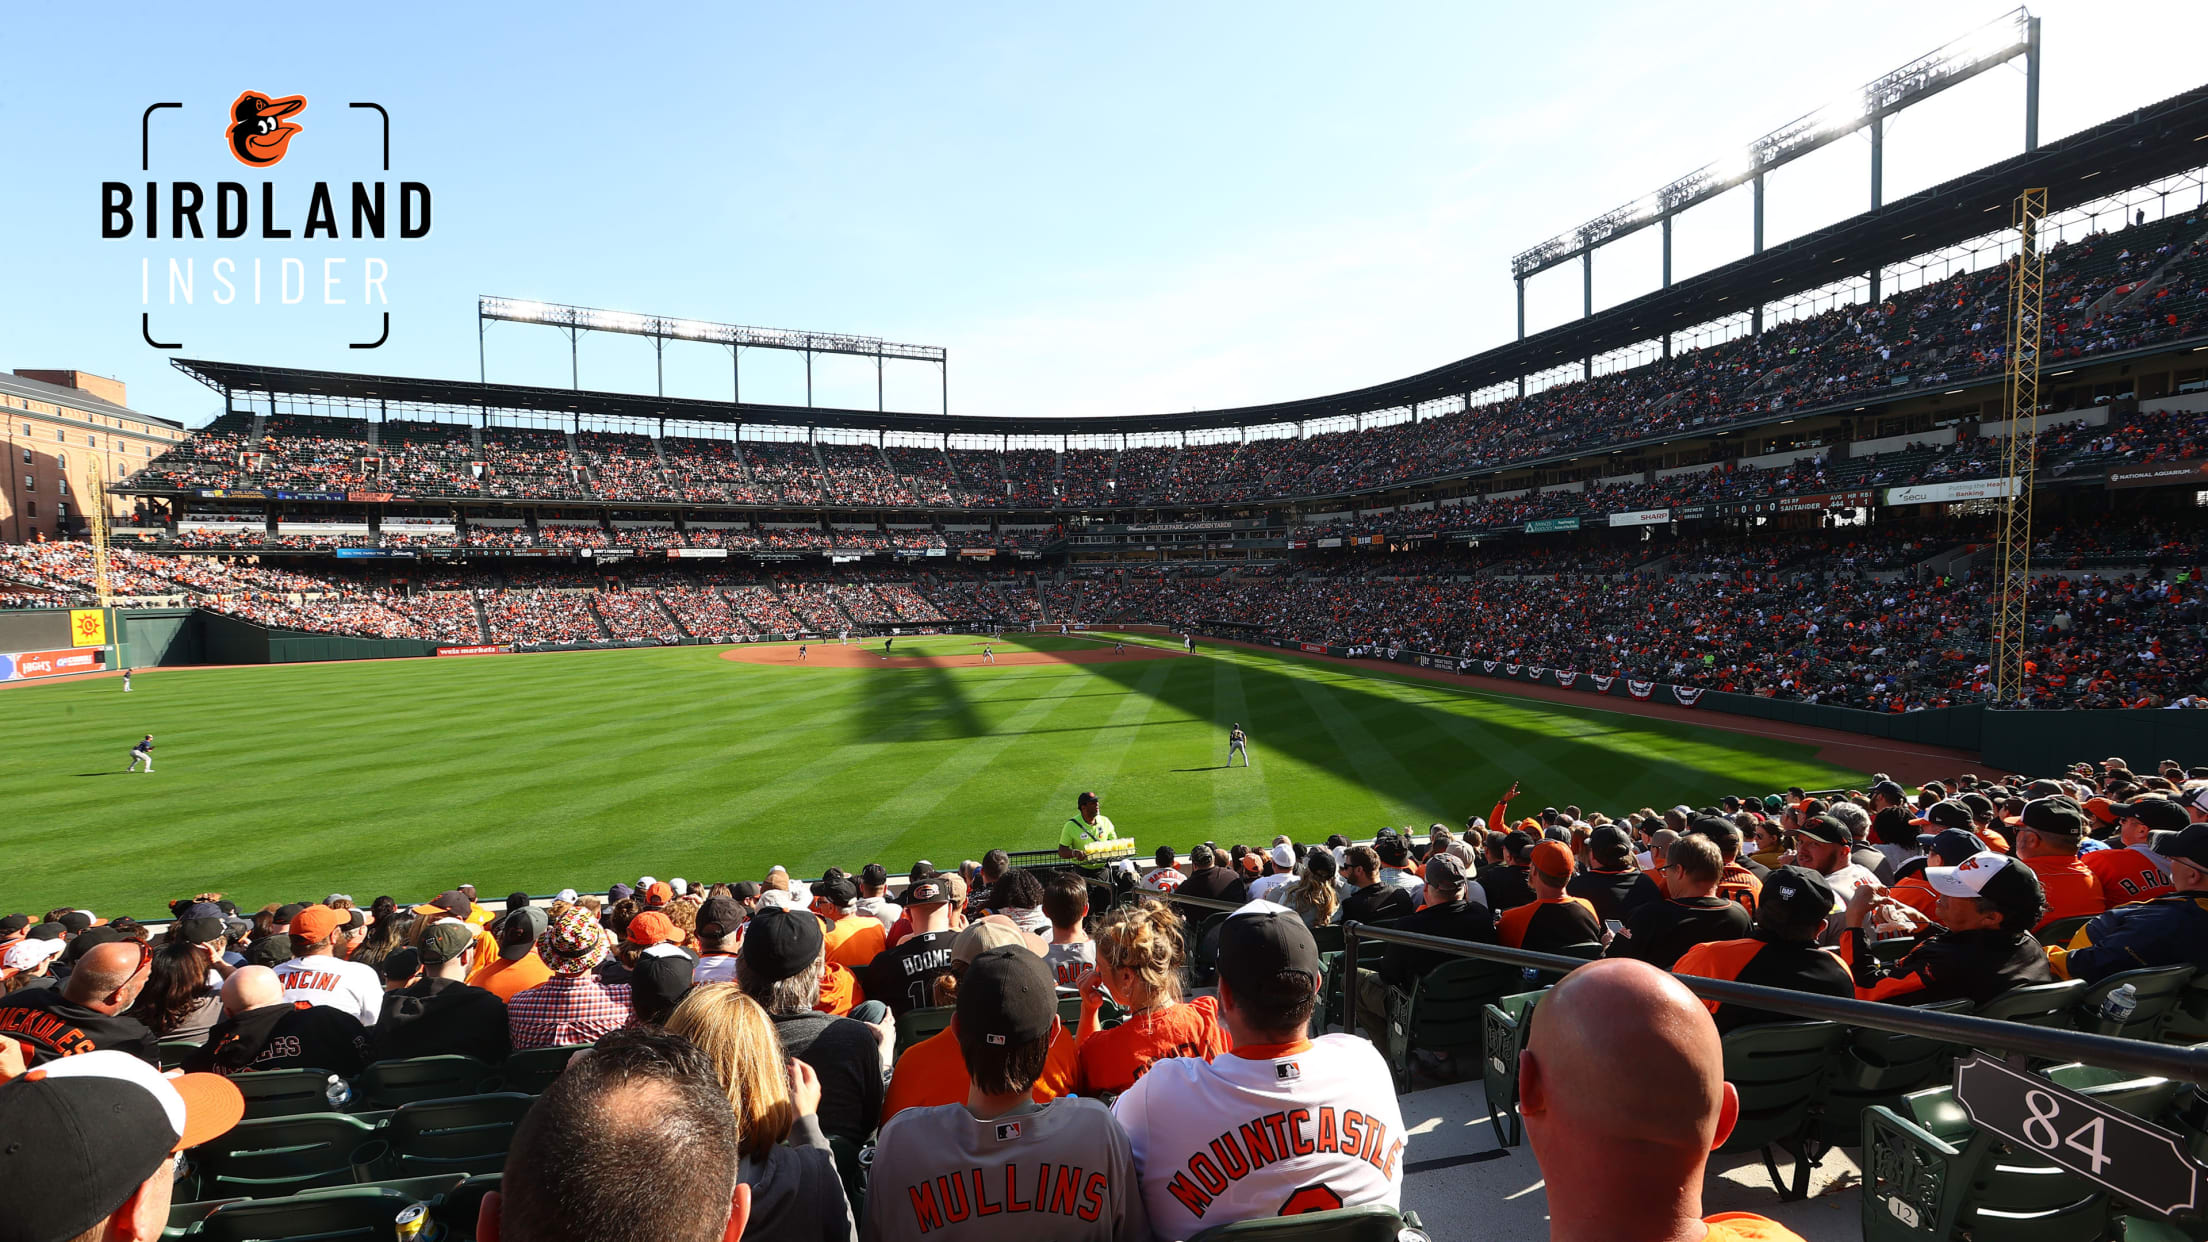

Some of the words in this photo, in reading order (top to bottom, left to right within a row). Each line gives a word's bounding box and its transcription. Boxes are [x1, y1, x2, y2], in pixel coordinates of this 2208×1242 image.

[1986, 480, 2007, 488] Heart
[1903, 493, 1927, 502] secu
[1955, 490, 1985, 498] Banking
[1780, 502, 1821, 512] SANTANDER
[1640, 512, 1668, 520] SHARP
[1420, 655, 1430, 667] Lite
[2022, 1089, 2112, 1175] 84
[1166, 1106, 1403, 1220] MOUNTCASTLE
[907, 1162, 1108, 1234] MULLINS
[1895, 1202, 1912, 1223] 12
